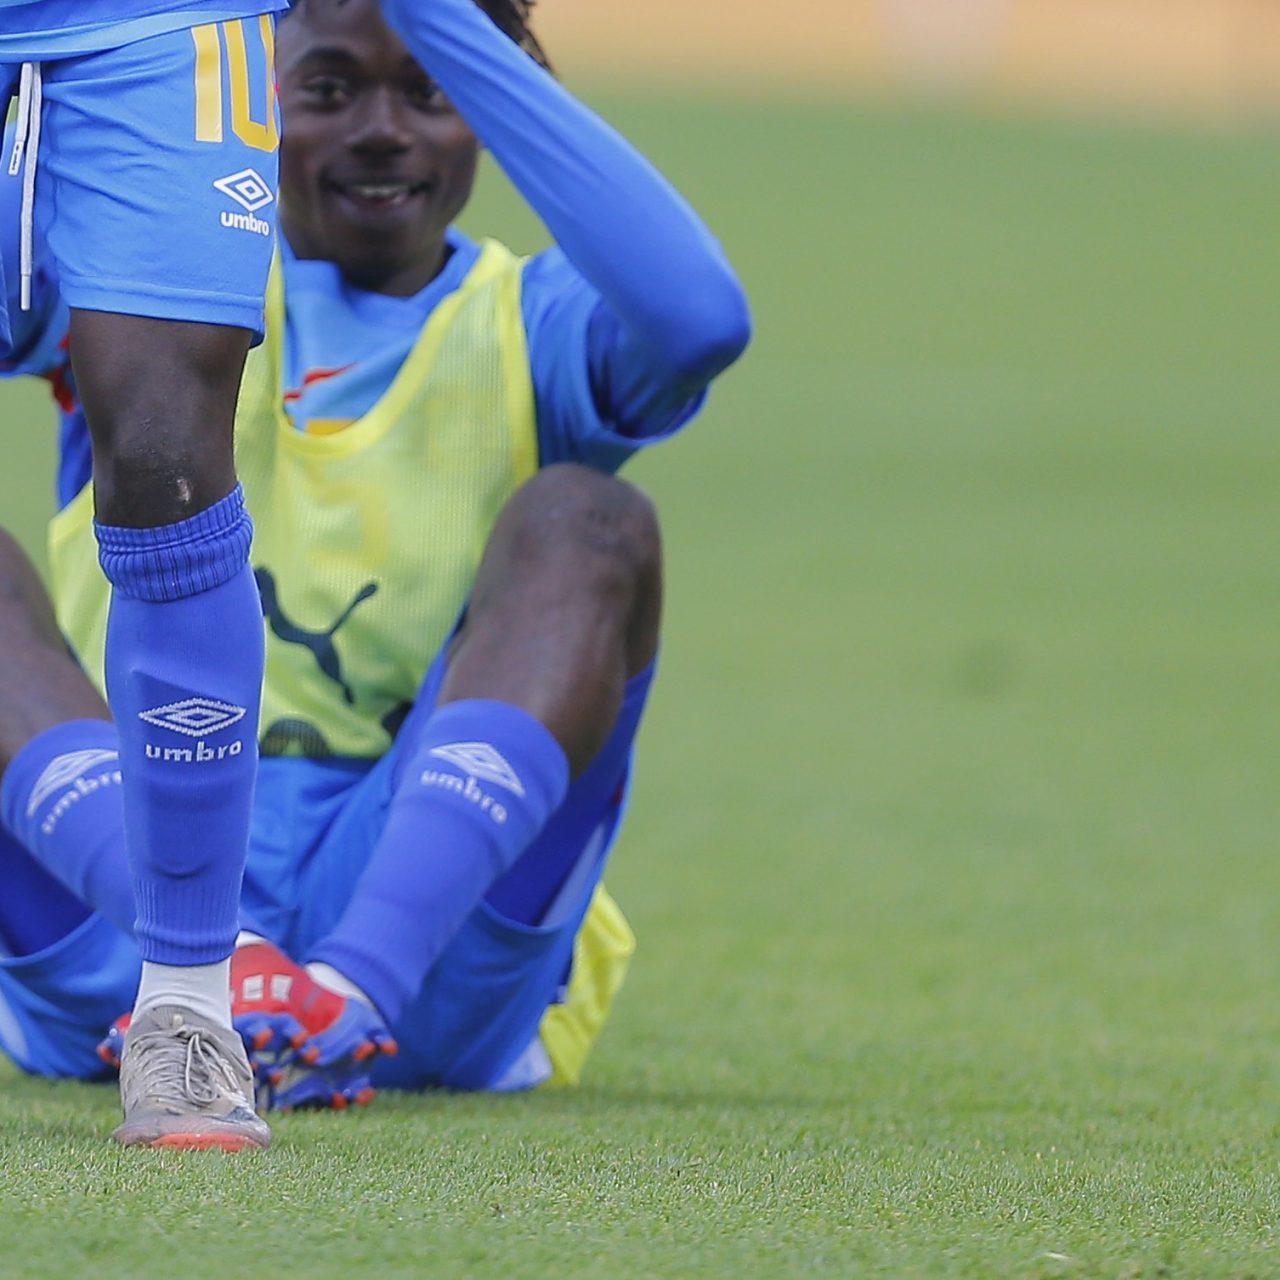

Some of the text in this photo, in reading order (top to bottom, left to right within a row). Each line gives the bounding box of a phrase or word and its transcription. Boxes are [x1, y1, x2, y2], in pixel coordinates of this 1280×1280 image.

[191, 14, 279, 152] 10
[221, 211, 269, 236] umbro
[145, 740, 242, 763] umbro
[421, 770, 508, 824] umbro
